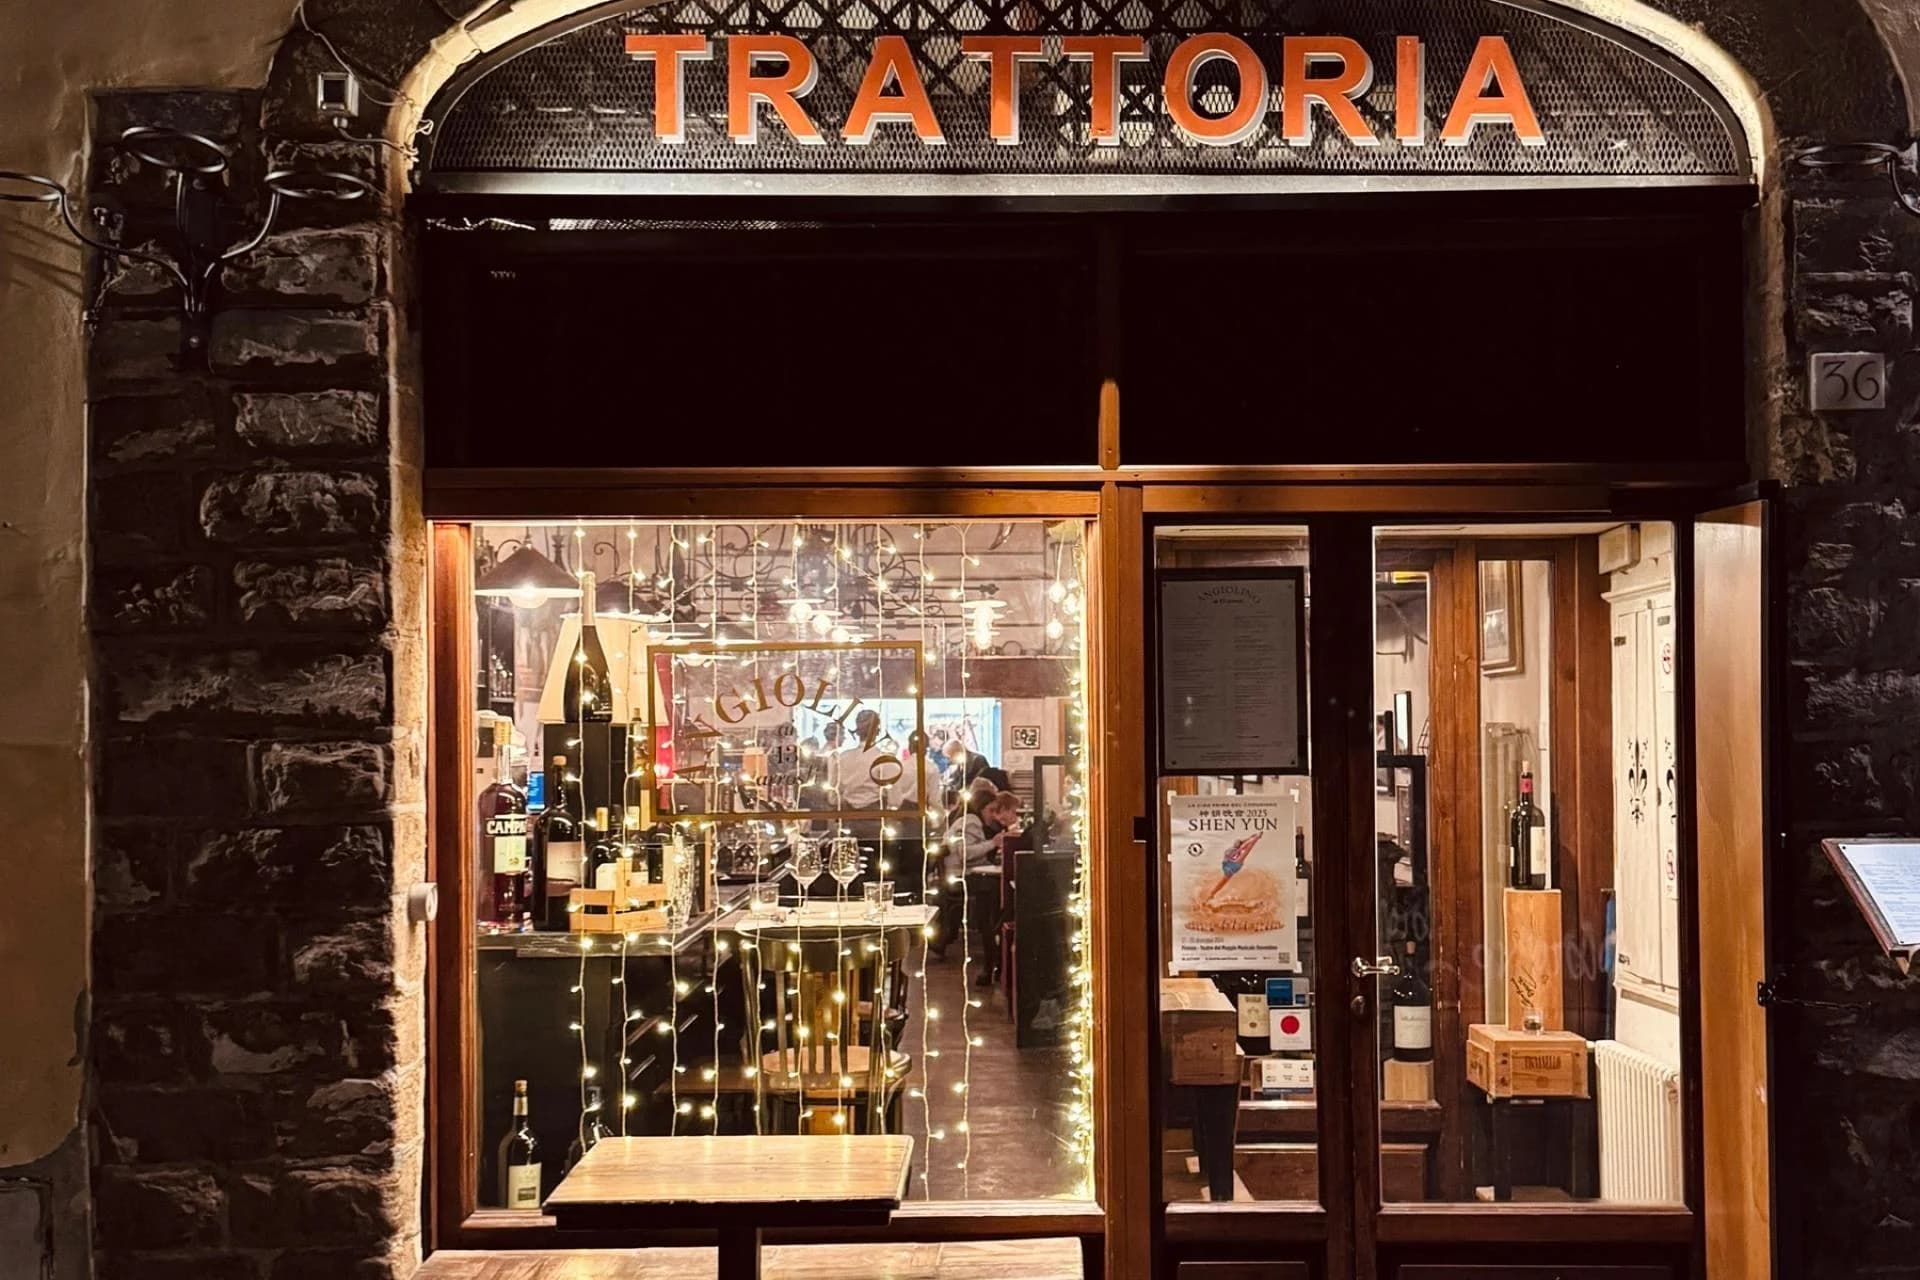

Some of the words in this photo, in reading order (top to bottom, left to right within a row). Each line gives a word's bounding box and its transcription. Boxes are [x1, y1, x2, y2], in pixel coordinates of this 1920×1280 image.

[624, 33, 1548, 149] TRATTORIA
[1823, 361, 1880, 402] 36
[674, 672, 904, 787] ANGIOLINO
[776, 744, 799, 764] 13
[1187, 818, 1236, 832] SHEN
[1242, 817, 1278, 832] YUN
[1246, 809, 1268, 818] 2025
